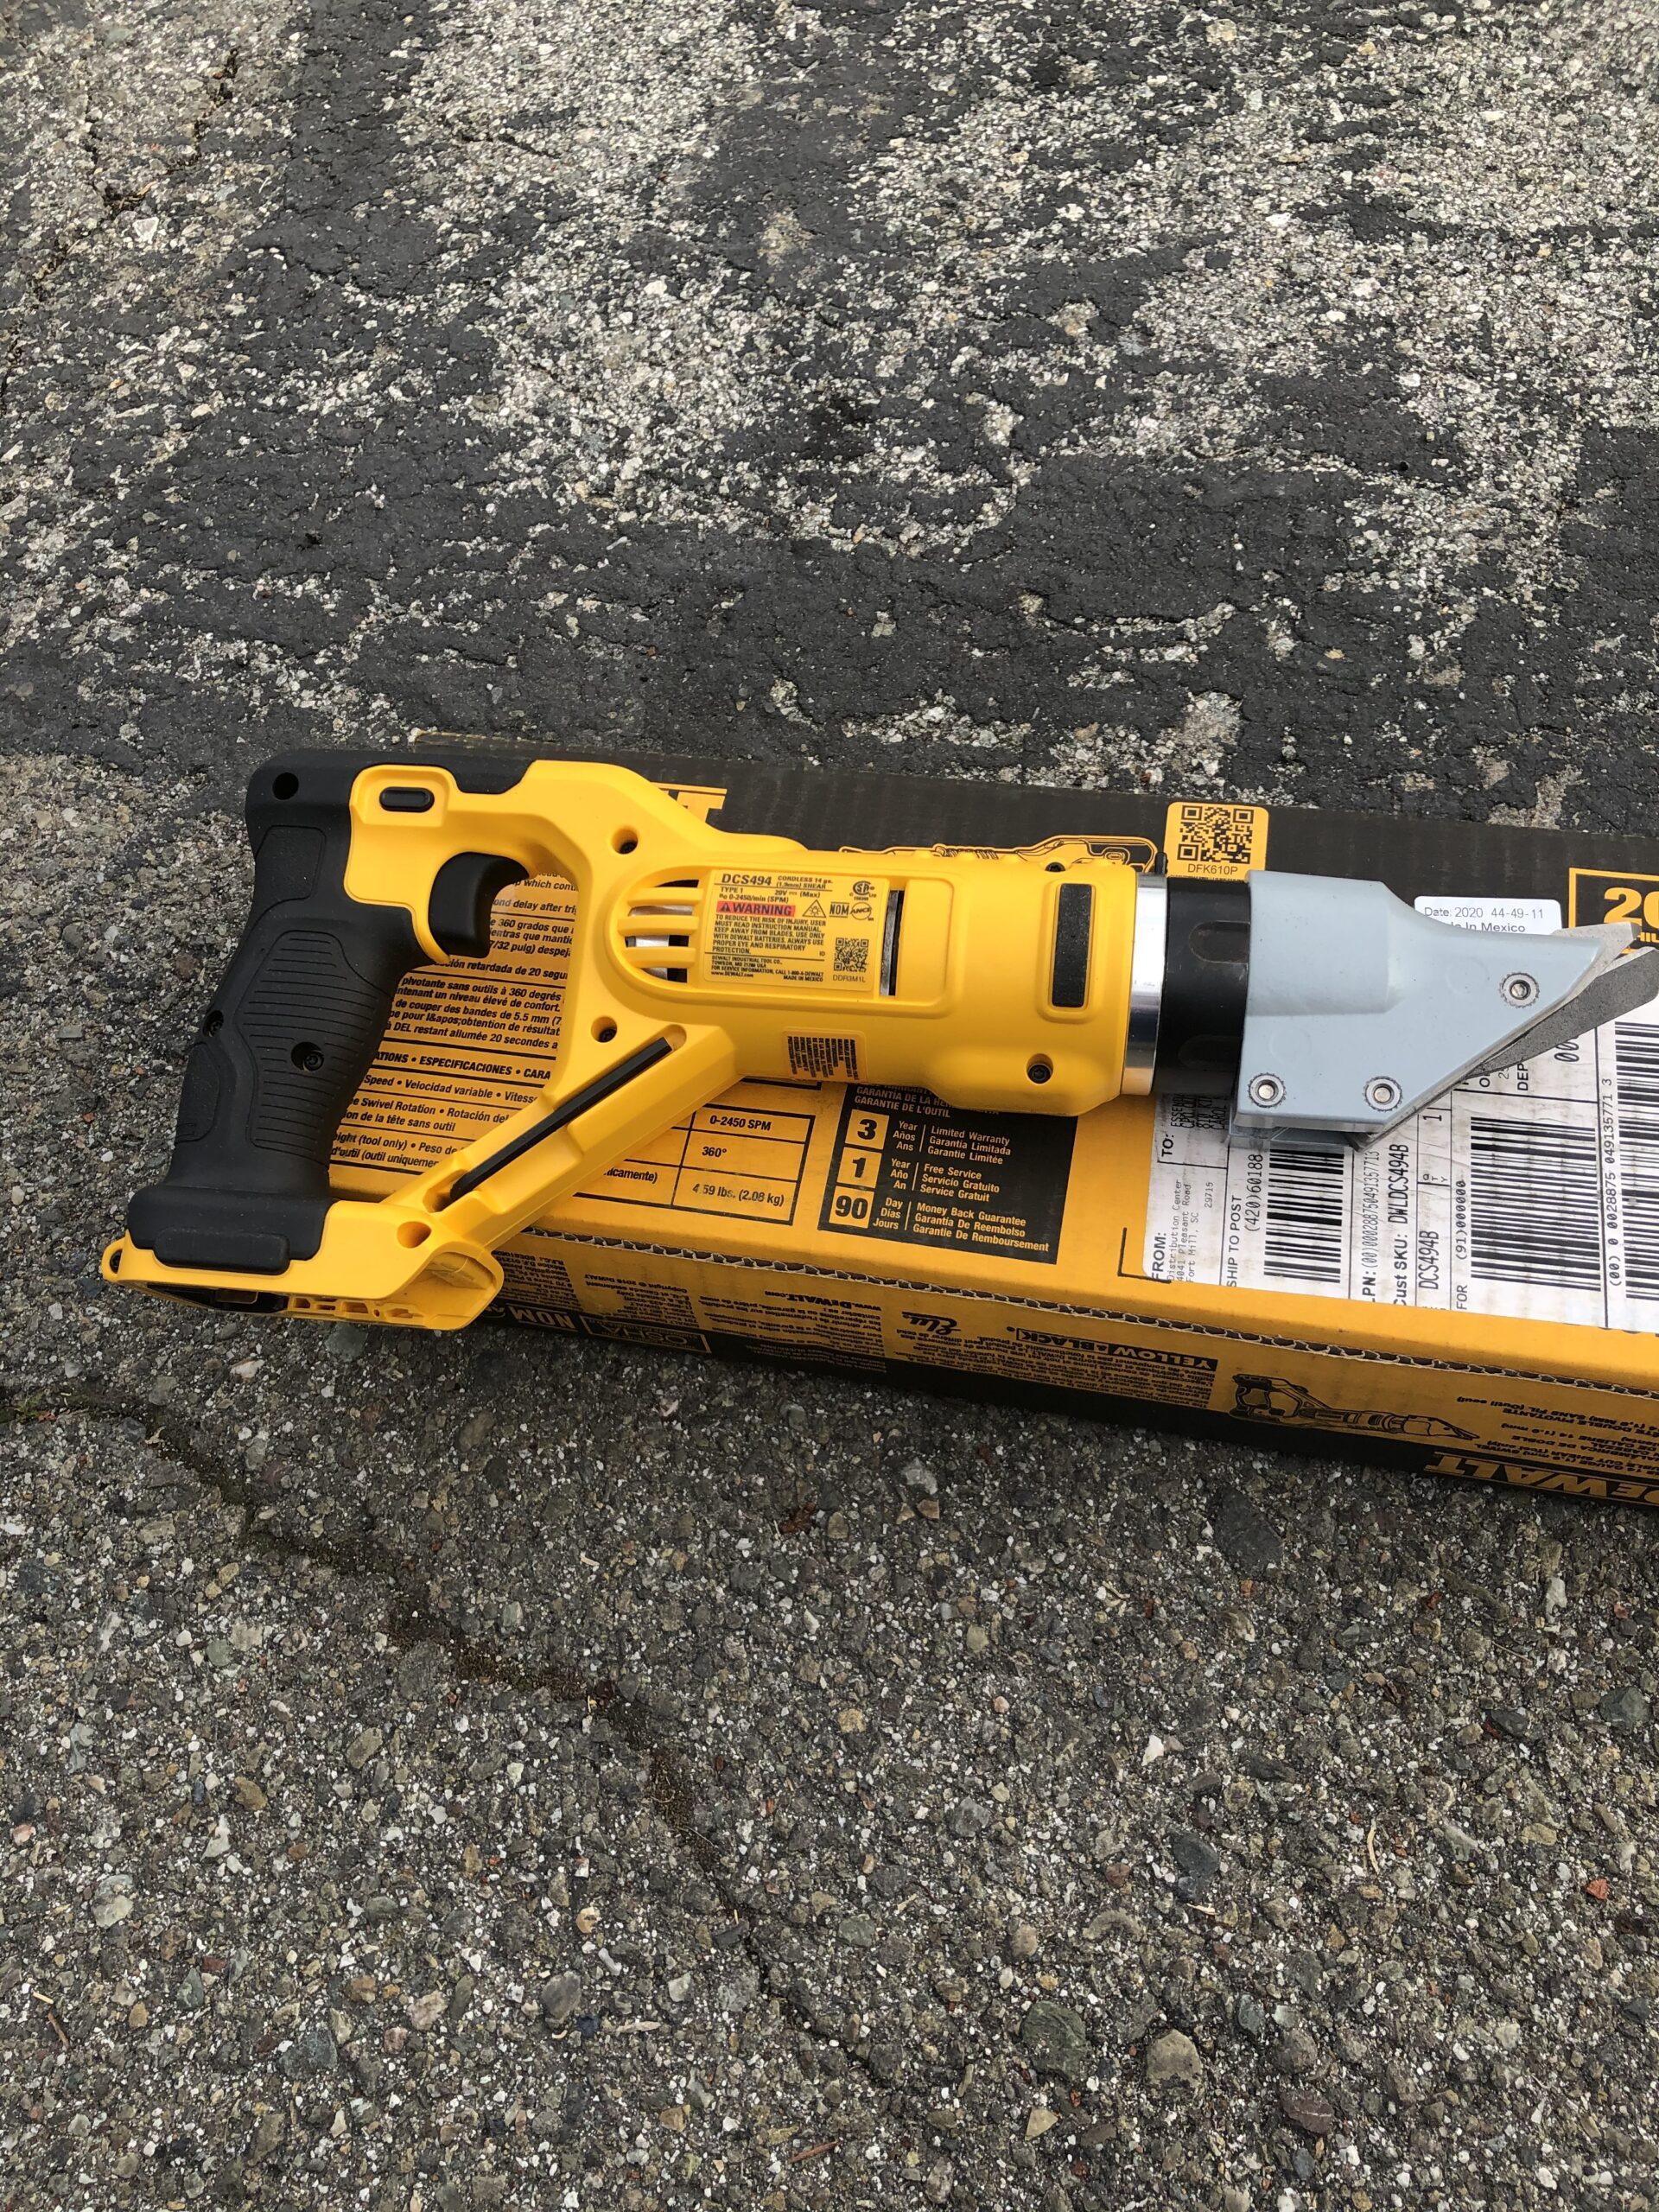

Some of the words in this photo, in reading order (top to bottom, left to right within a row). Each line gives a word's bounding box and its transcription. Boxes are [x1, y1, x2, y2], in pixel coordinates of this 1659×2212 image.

[721, 874, 772, 886] DCS494
[1188, 864, 1238, 874] DFK610P
[524, 879, 551, 889] which
[513, 900, 537, 911] delay
[540, 903, 563, 912] after
[733, 904, 791, 916] WARNING
[830, 904, 849, 915] NOM
[1425, 907, 1452, 917] Date:
[1455, 907, 1484, 918] 2020
[1491, 908, 1543, 918] 44-49-11
[518, 921, 550, 931] grados
[551, 924, 569, 933] que
[523, 931, 540, 942] que
[1482, 923, 1525, 932] Mexico
[765, 943, 805, 951] RESPIRATORY
[467, 962, 512, 972] retardada
[515, 964, 527, 974] de
[401, 977, 446, 988] pivotante
[448, 982, 470, 991] sans
[472, 984, 499, 995] outils
[509, 988, 527, 997] 360
[529, 990, 561, 1001] degrés
[396, 999, 407, 1007] de
[410, 1001, 442, 1013] couper
[444, 1004, 461, 1014] des
[463, 1006, 497, 1018] bandes
[500, 1010, 512, 1020] de
[514, 1012, 528, 1020] 5.5
[531, 1015, 550, 1024] mm
[449, 992, 480, 1002] niveau
[482, 995, 508, 1006] élevé
[510, 998, 522, 1007] de
[524, 999, 560, 1012] confort.
[402, 1012, 424, 1021] pour
[508, 1021, 520, 1031] de
[394, 1022, 411, 1032] DEL
[414, 1025, 448, 1036] restant
[449, 1028, 487, 1041] allumée
[489, 1033, 503, 1042] 20
[504, 1035, 550, 1049] secondes
[419, 1056, 512, 1076] ESPECIFICACIONES
[405, 1079, 452, 1094] Velocidad
[454, 1086, 493, 1098] variable
[361, 1097, 393, 1109] Swivel
[396, 1102, 435, 1115] Rotation
[447, 1108, 490, 1122] Rotación
[855, 1096, 899, 1111] GARANTIE
[902, 1103, 915, 1112] DE
[360, 1112, 372, 1121] de
[374, 1114, 384, 1122] la
[387, 1114, 404, 1125] tête
[408, 1119, 430, 1128] sans
[433, 1122, 456, 1132] outil
[710, 1116, 746, 1128] 0-2450
[748, 1119, 771, 1131] SPM
[857, 1119, 878, 1140] 3
[1602, 1093, 1615, 1164] 049135771
[359, 1135, 381, 1147] (tool
[383, 1138, 408, 1150] only)
[419, 1142, 442, 1154] Peso
[893, 1130, 915, 1141] Años
[971, 1143, 1011, 1156] Limitada
[899, 1121, 918, 1131] Year
[931, 1126, 965, 1139] Limited
[969, 1132, 1010, 1147] Warranty
[362, 1149, 385, 1161] (outil
[702, 1147, 727, 1157] 360°
[897, 1141, 913, 1151] Ans
[928, 1147, 966, 1160] Garantie
[969, 1152, 1003, 1165] Limitée
[1161, 1134, 1173, 1157] TO:
[852, 1157, 867, 1179] 1
[891, 1159, 910, 1169] Year
[924, 1164, 944, 1174] Free
[948, 1167, 982, 1179] Service
[891, 1168, 908, 1179] Año
[922, 1174, 959, 1186] Servicio
[963, 1180, 1000, 1193] Gratuito
[893, 1180, 906, 1190] An
[920, 1185, 954, 1197] Service
[958, 1190, 989, 1202] Gratuit
[1388, 1144, 1408, 1224] DWLDCS494B
[717, 1185, 735, 1198] lbs.
[767, 1193, 785, 1206] kg)
[1173, 1180, 1181, 1211] Center
[1182, 1184, 1191, 1206] Road
[1205, 1182, 1214, 1208] 29715
[1244, 1154, 1263, 1231] (420)60188
[1606, 1173, 1618, 1229] 0028875
[835, 1196, 868, 1220] 90
[886, 1198, 903, 1209] Day
[917, 1203, 947, 1216] Money
[951, 1207, 975, 1219] Back
[978, 1211, 1027, 1226] Guarantee
[1230, 1195, 1242, 1231] POST
[957, 1219, 970, 1229] De
[974, 1221, 1026, 1237] Reembolso
[1456, 1180, 1466, 1260] (91)000000
[873, 1217, 899, 1230] Jours
[913, 1224, 951, 1237] Garantie
[956, 1230, 968, 1240] De
[972, 1234, 1050, 1252] Remboursement
[1229, 1233, 1240, 1252] TO
[1152, 1232, 1166, 1281] FROM:
[1394, 1234, 1408, 1269] SKU:
[1419, 1230, 1439, 1289] DCS494B
[1610, 1255, 1621, 1286] (00)
[1457, 1285, 1467, 1310] FOR
[508, 1306, 575, 1329] NOM
[601, 1325, 687, 1344] OSHA
[1019, 1332, 1096, 1350] BLACK
[1113, 1346, 1211, 1369] YELLOW
